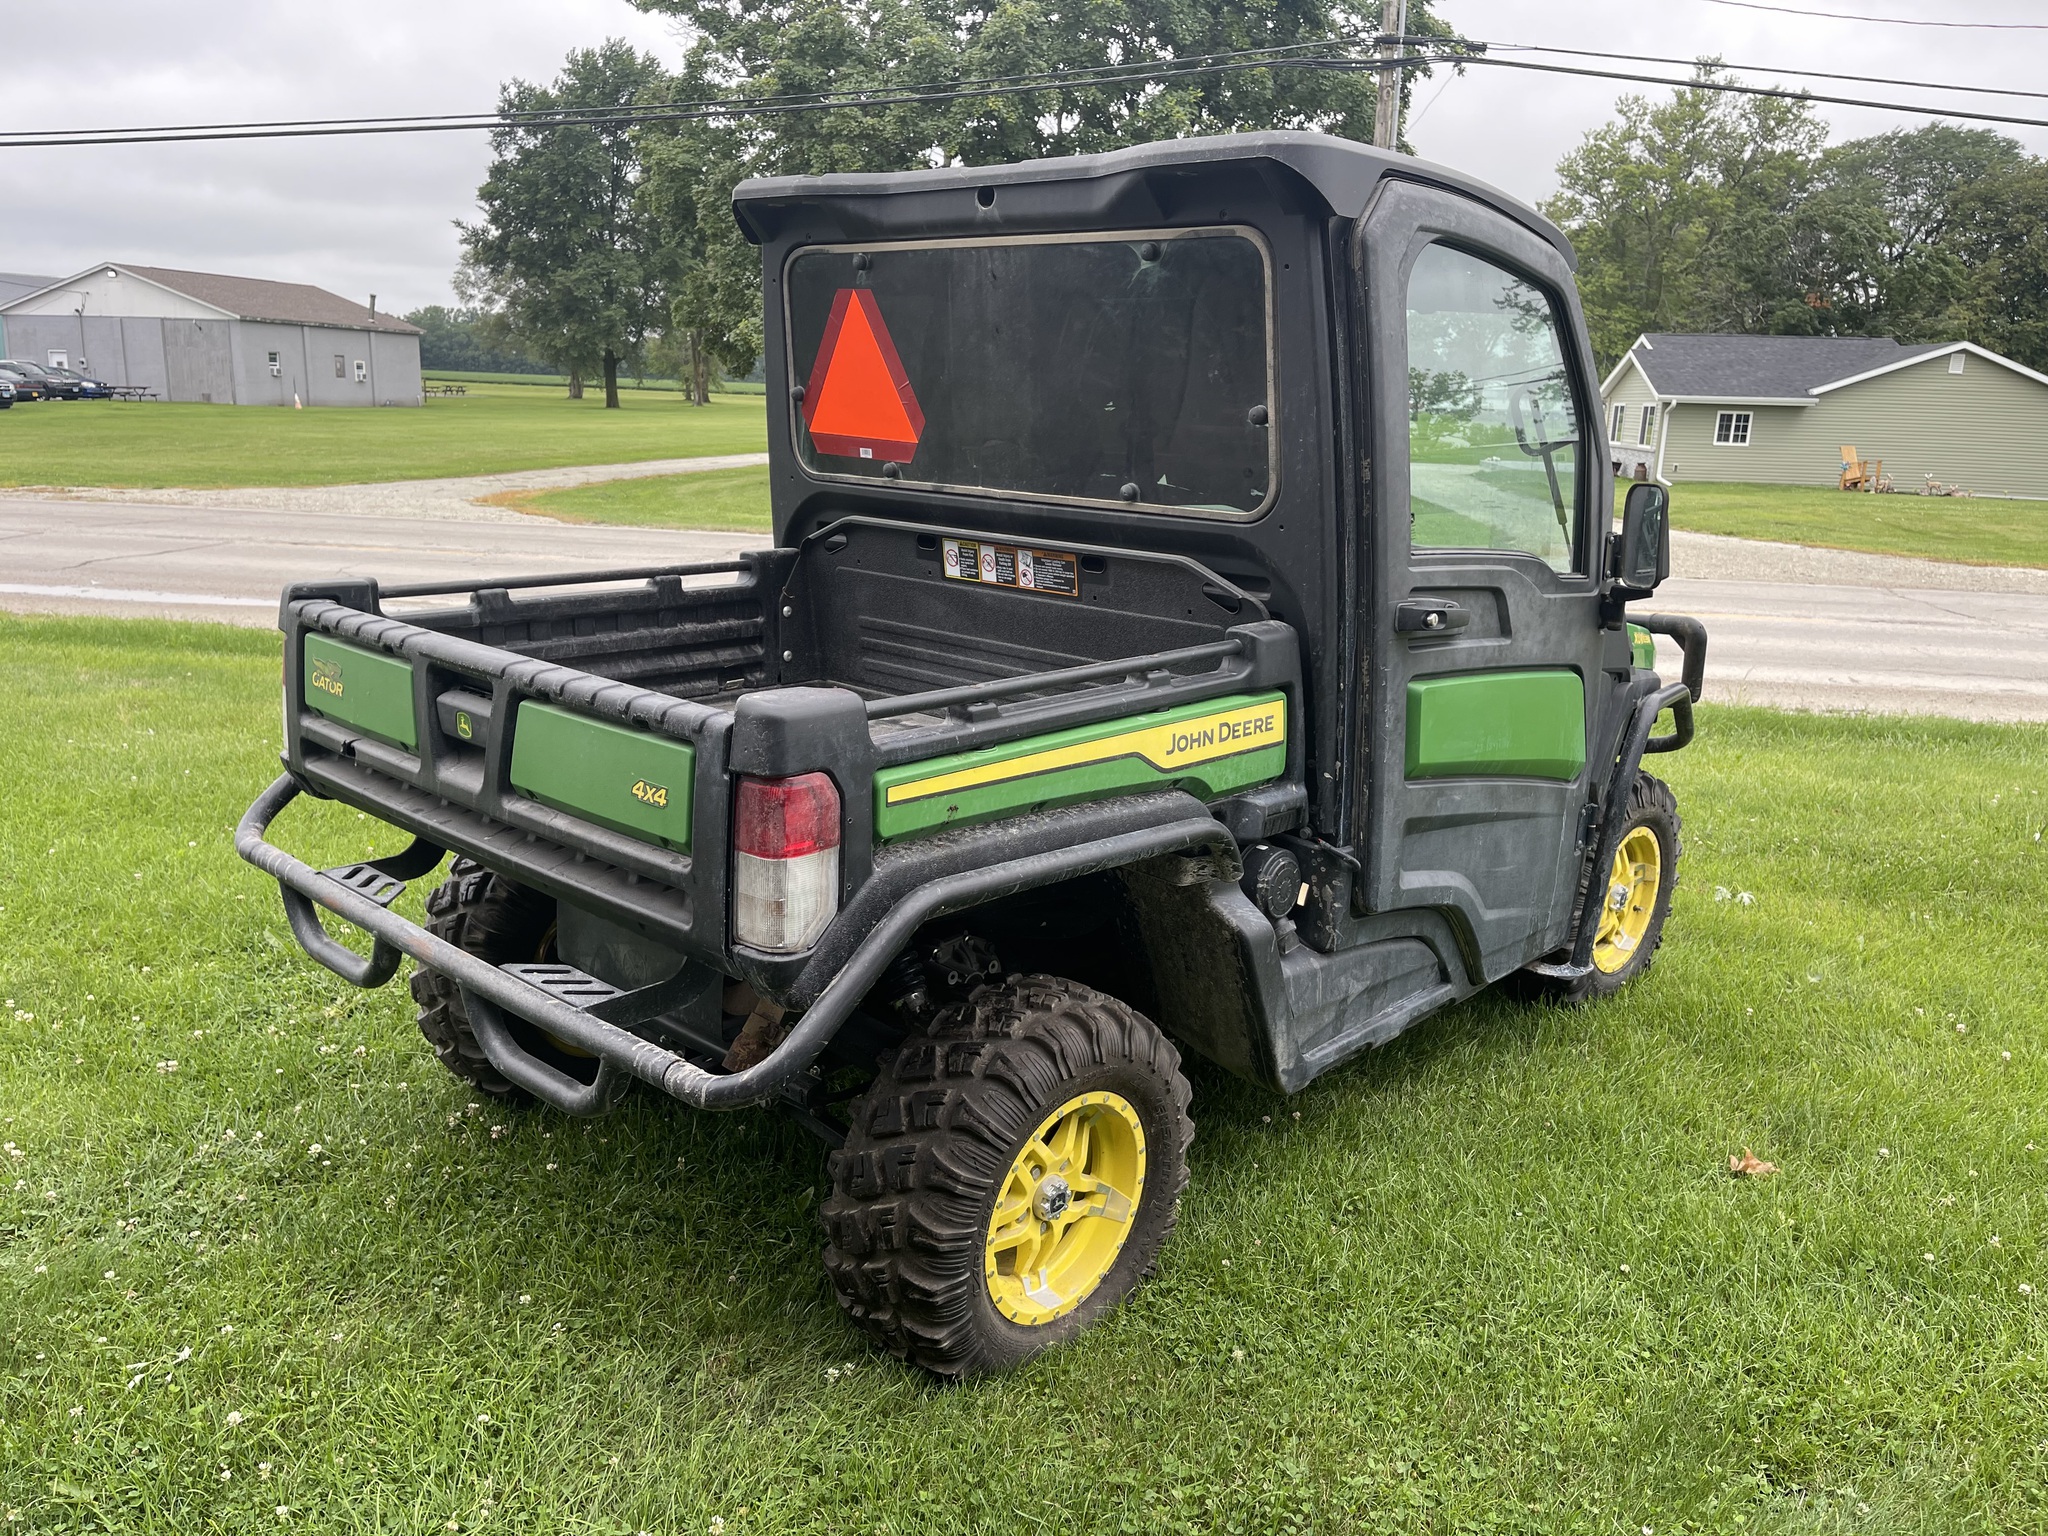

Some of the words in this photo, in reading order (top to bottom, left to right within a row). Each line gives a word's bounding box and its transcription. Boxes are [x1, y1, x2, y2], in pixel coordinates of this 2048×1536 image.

[312, 671, 344, 697] GATOR
[1166, 728, 1215, 756] JOHN
[1218, 714, 1275, 743] DEERE
